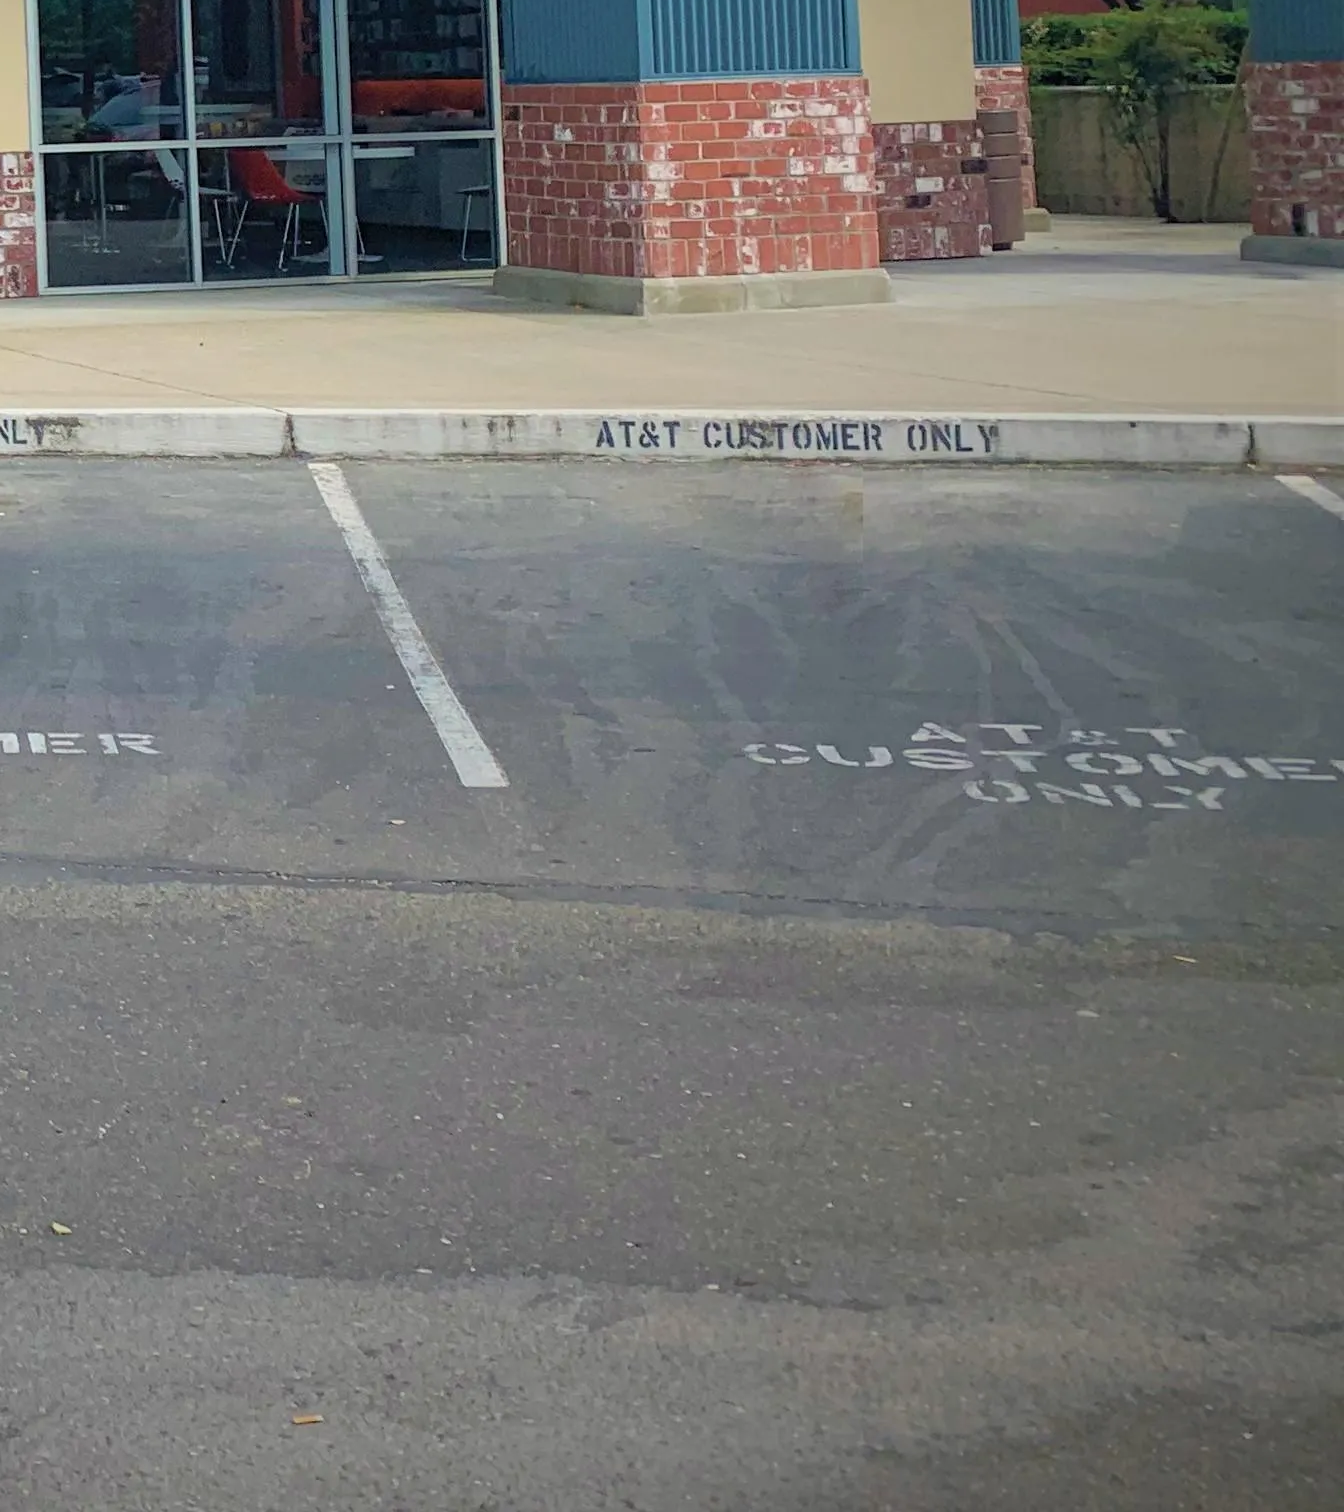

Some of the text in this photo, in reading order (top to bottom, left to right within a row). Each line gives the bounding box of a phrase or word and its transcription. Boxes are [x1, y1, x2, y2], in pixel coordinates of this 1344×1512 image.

[595, 419, 999, 454] AT&T CUSTOMER ONLY
[910, 721, 1188, 748] AT&T
[743, 743, 1344, 782] CUSTOME
[963, 779, 1226, 811] ONLY
